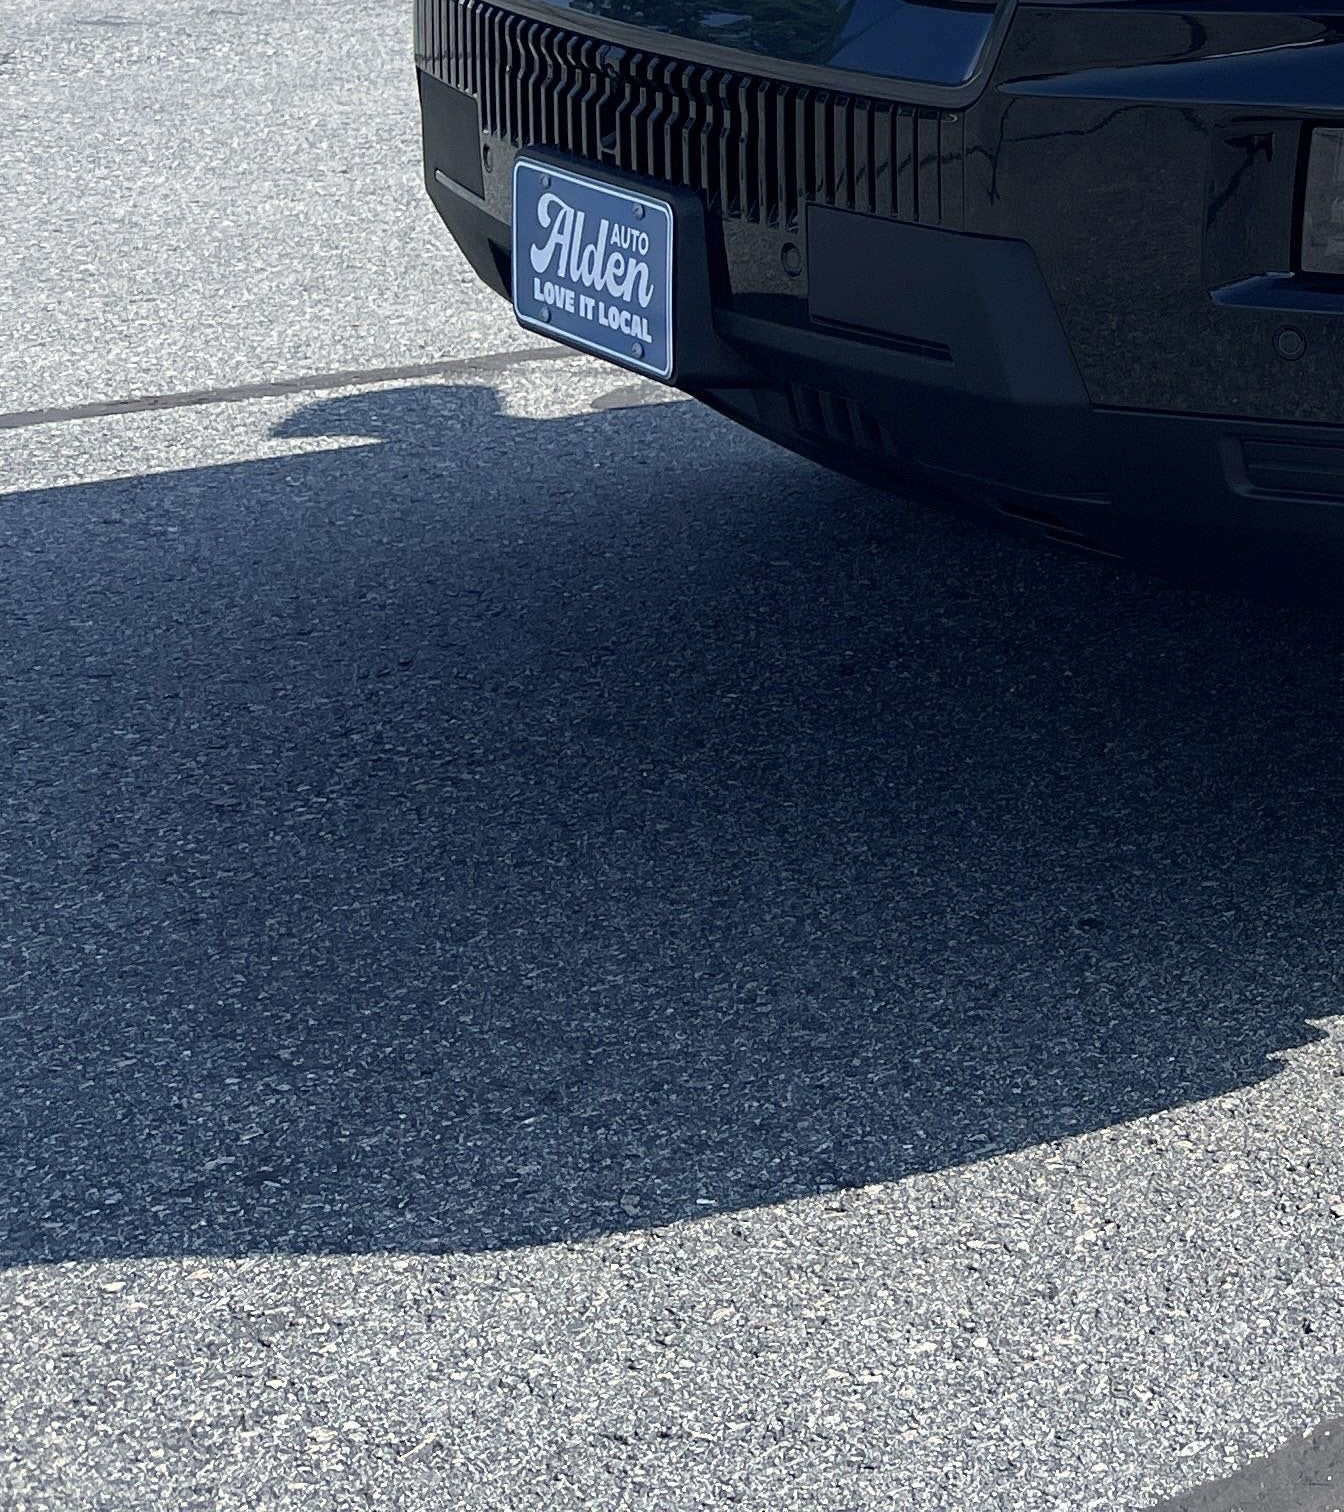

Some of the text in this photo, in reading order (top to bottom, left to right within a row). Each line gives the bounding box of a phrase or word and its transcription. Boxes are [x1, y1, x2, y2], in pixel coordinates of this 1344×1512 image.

[529, 192, 654, 308] Alden
[610, 223, 650, 256] AUTO
[533, 277, 653, 344] LOVE IT LOCAL
